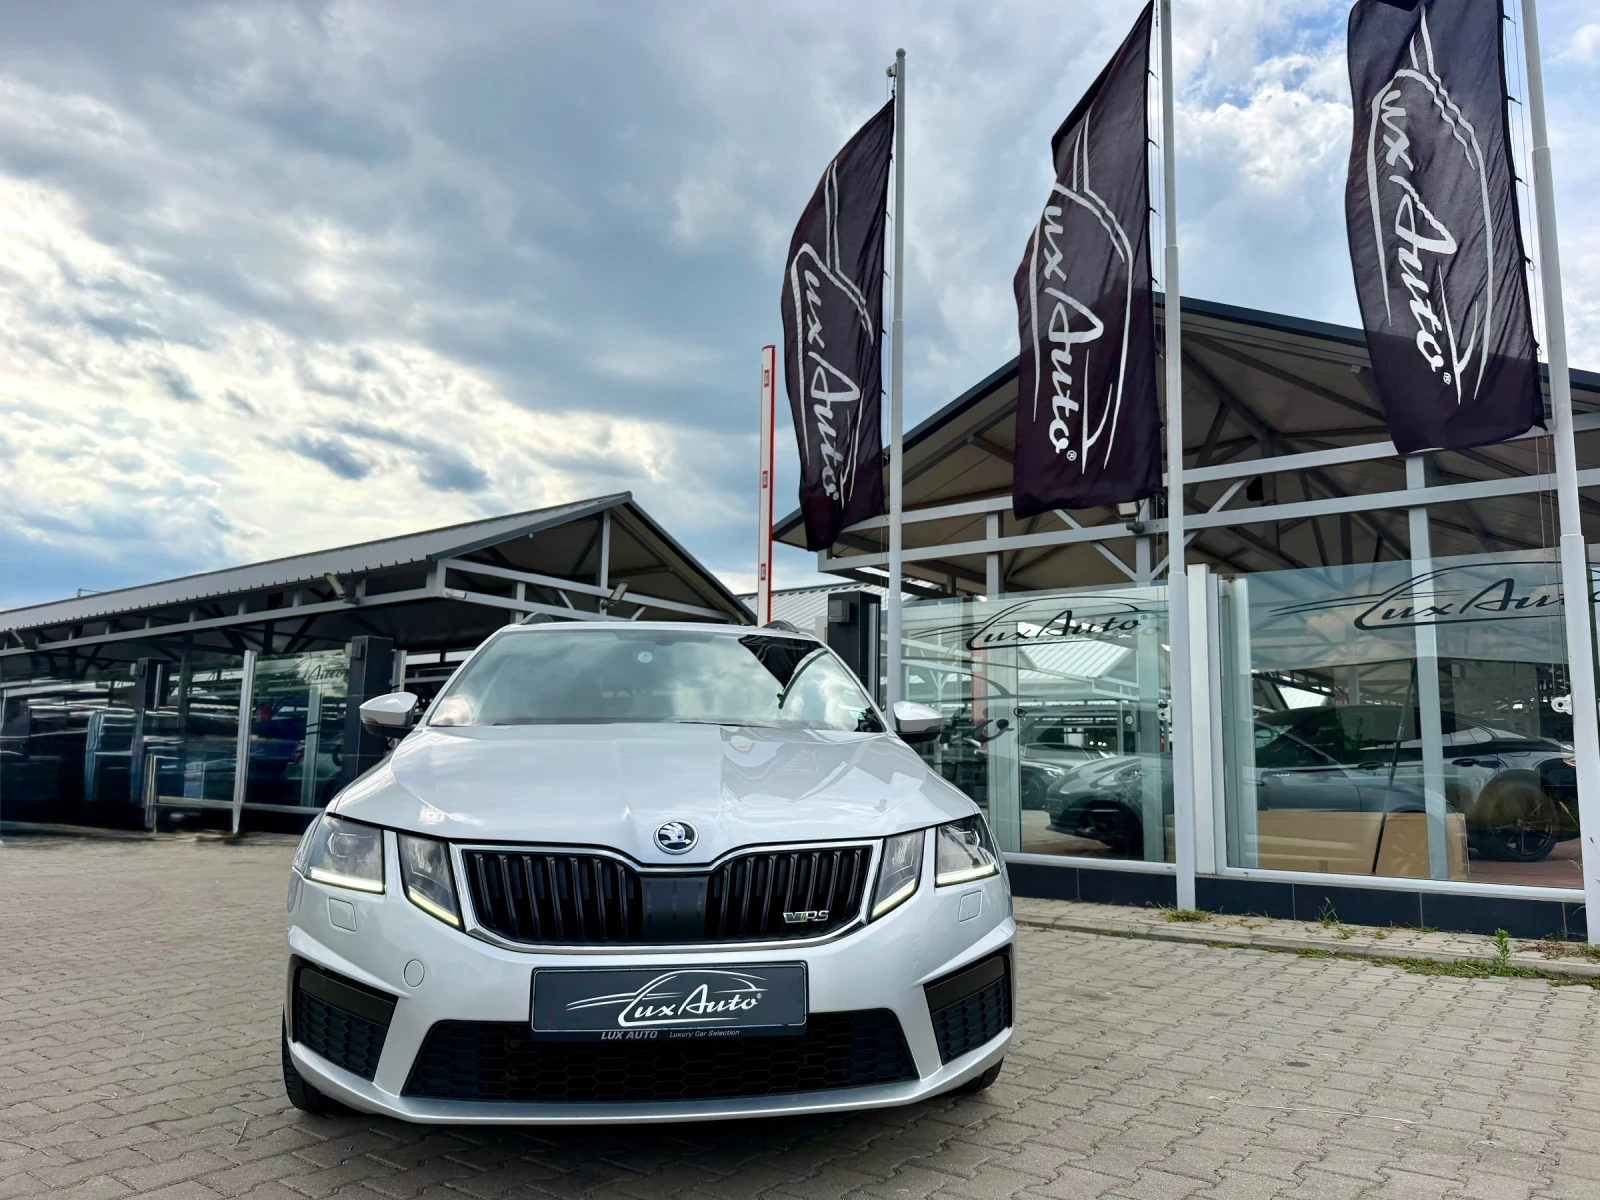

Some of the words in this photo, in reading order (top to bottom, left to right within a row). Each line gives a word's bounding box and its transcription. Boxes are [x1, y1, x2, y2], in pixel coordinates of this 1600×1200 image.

[1389, 174, 1458, 374] Auto
[1044, 286, 1105, 455] Auto
[808, 351, 861, 499] Auto
[1035, 609, 1141, 639] Auto
[600, 1030, 625, 1040] LUX
[625, 1030, 658, 1040] AUTO
[669, 1030, 694, 1039] Luxury
[707, 1029, 740, 1037] Selection
[677, 983, 759, 1016] Auto
